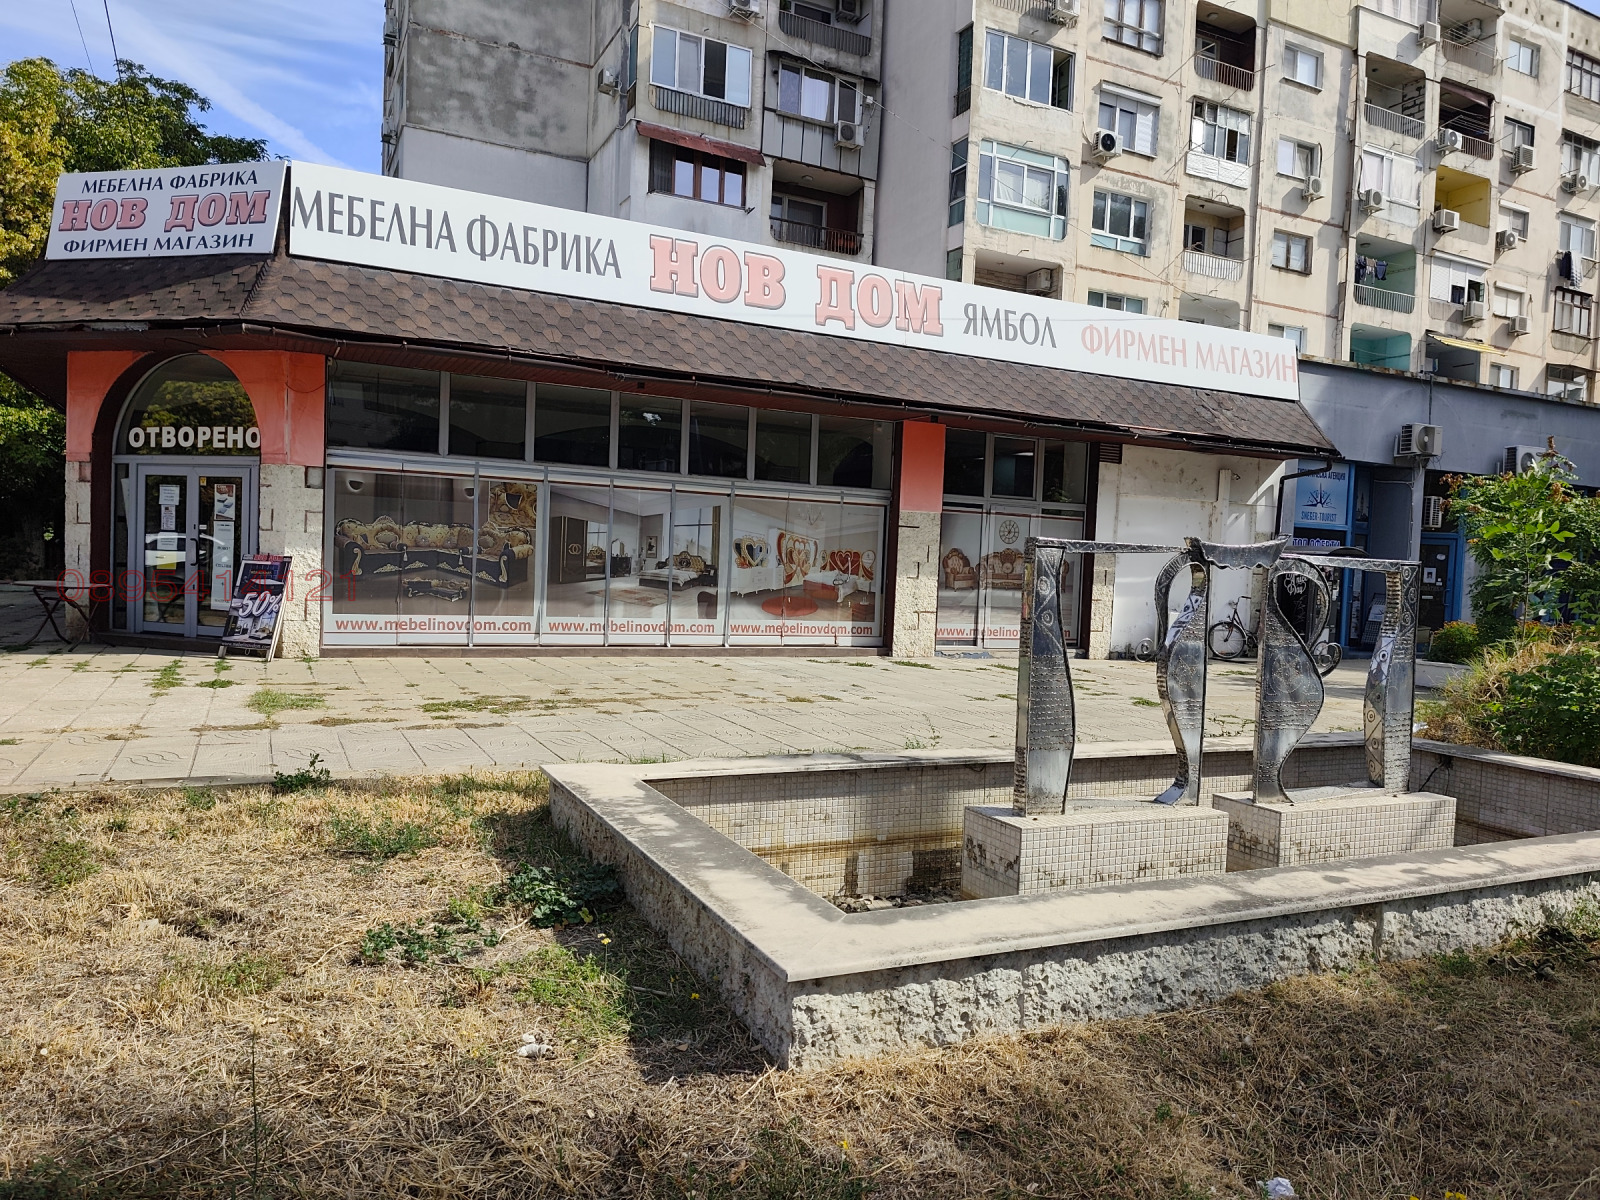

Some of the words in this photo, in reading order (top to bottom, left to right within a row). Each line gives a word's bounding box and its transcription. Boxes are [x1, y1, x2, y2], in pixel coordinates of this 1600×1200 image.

[82, 176, 163, 194] МЕБЕЛНА
[170, 170, 258, 188] ФАБРИКА
[58, 197, 148, 232] НОВ
[164, 190, 271, 232] ДОМ
[63, 237, 148, 253] ФИРМЕН
[153, 234, 254, 251] МАГАЗИН
[291, 186, 457, 253] МЕБЕЛНА
[466, 214, 622, 279] ФАБРИКА
[649, 233, 786, 311] НОВ
[814, 263, 944, 337] ДОМ
[963, 302, 1057, 348] ЯМБОЛ
[1081, 323, 1188, 369] ФИРМЕН
[1195, 345, 1297, 383] МАГАЗИН
[128, 426, 261, 448] ОТВОРЕНО
[548, 619, 715, 633] www.mbelinovdom.com
[730, 622, 873, 635] www.mebelinovdom.com
